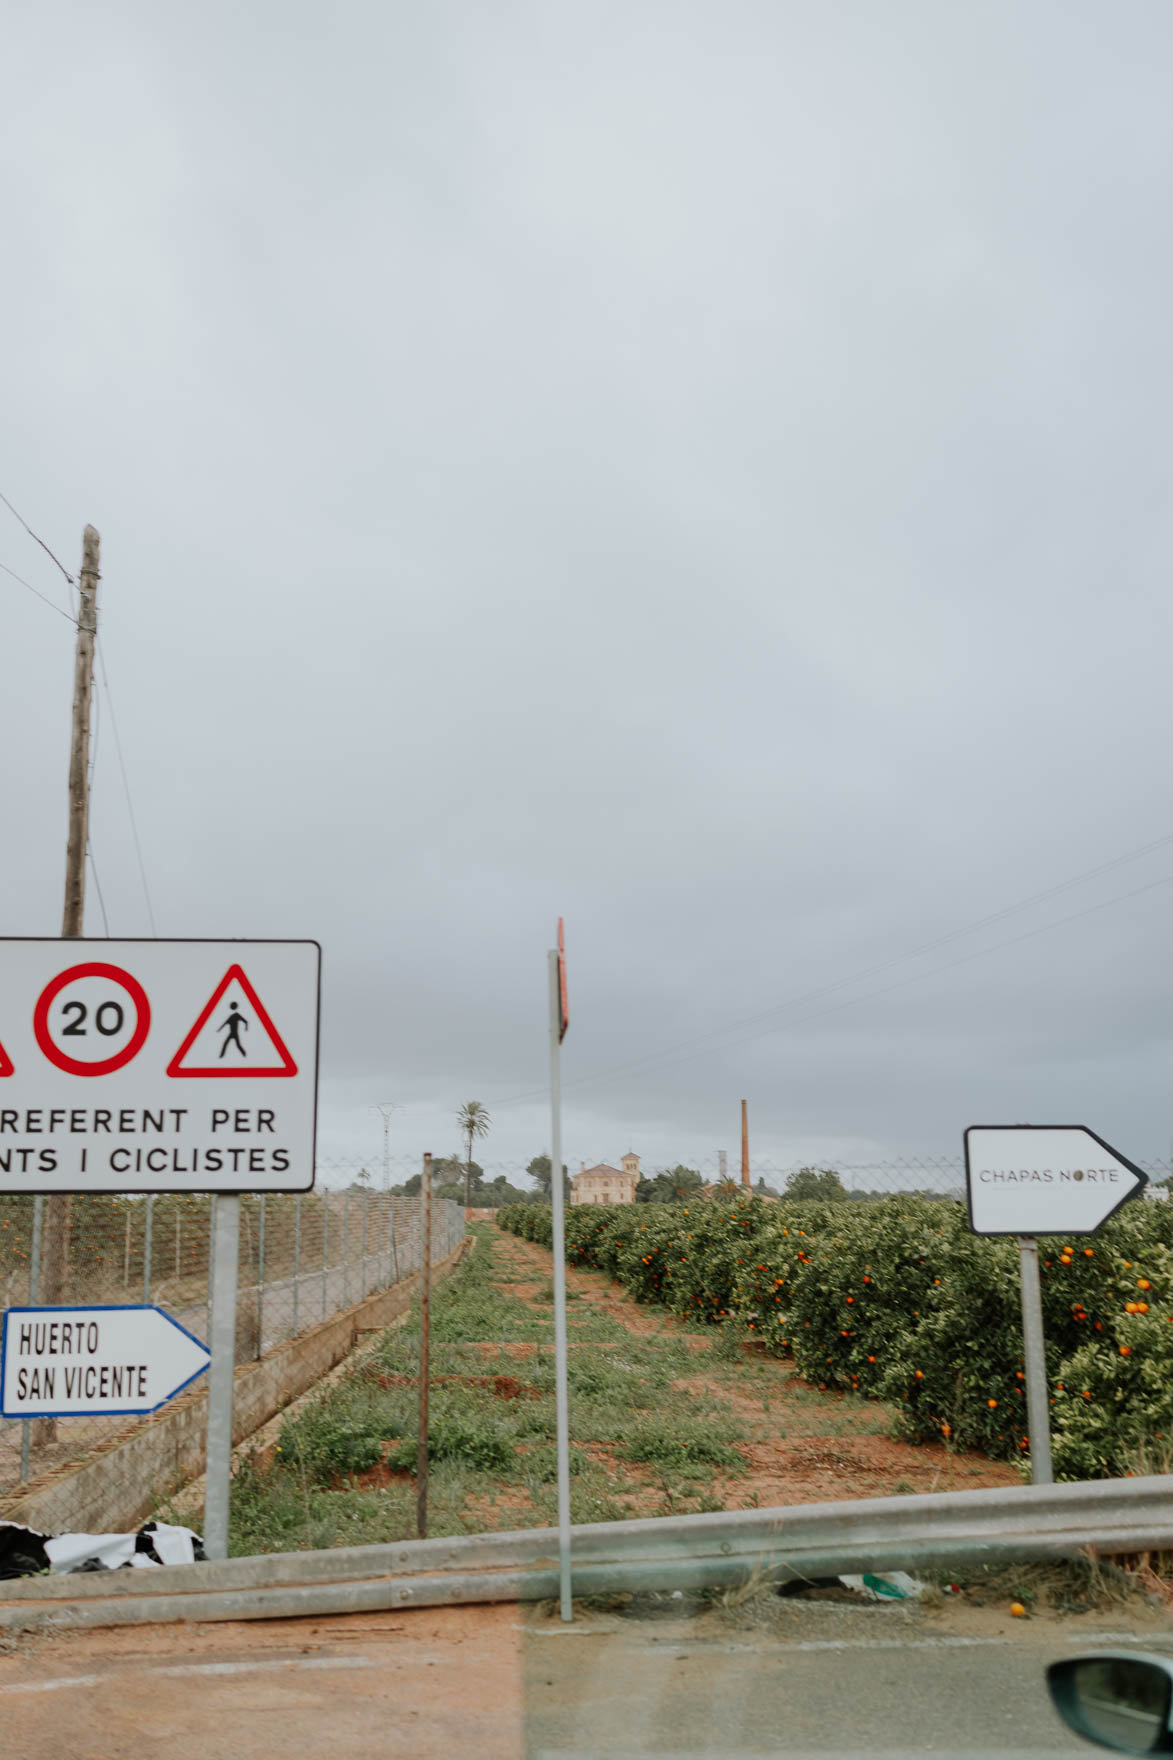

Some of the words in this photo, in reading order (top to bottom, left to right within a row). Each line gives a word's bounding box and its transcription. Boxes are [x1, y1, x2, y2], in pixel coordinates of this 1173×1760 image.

[62, 1001, 124, 1036] 20
[211, 1109, 276, 1133] PER
[80, 1148, 87, 1172] I
[109, 1148, 290, 1172] CICLISTES
[980, 1169, 1054, 1183] CHAPAS
[1060, 1169, 1119, 1182] NORTE
[19, 1321, 99, 1356] HUERTO
[17, 1367, 56, 1401] SAN
[64, 1365, 148, 1399] VICENTE
